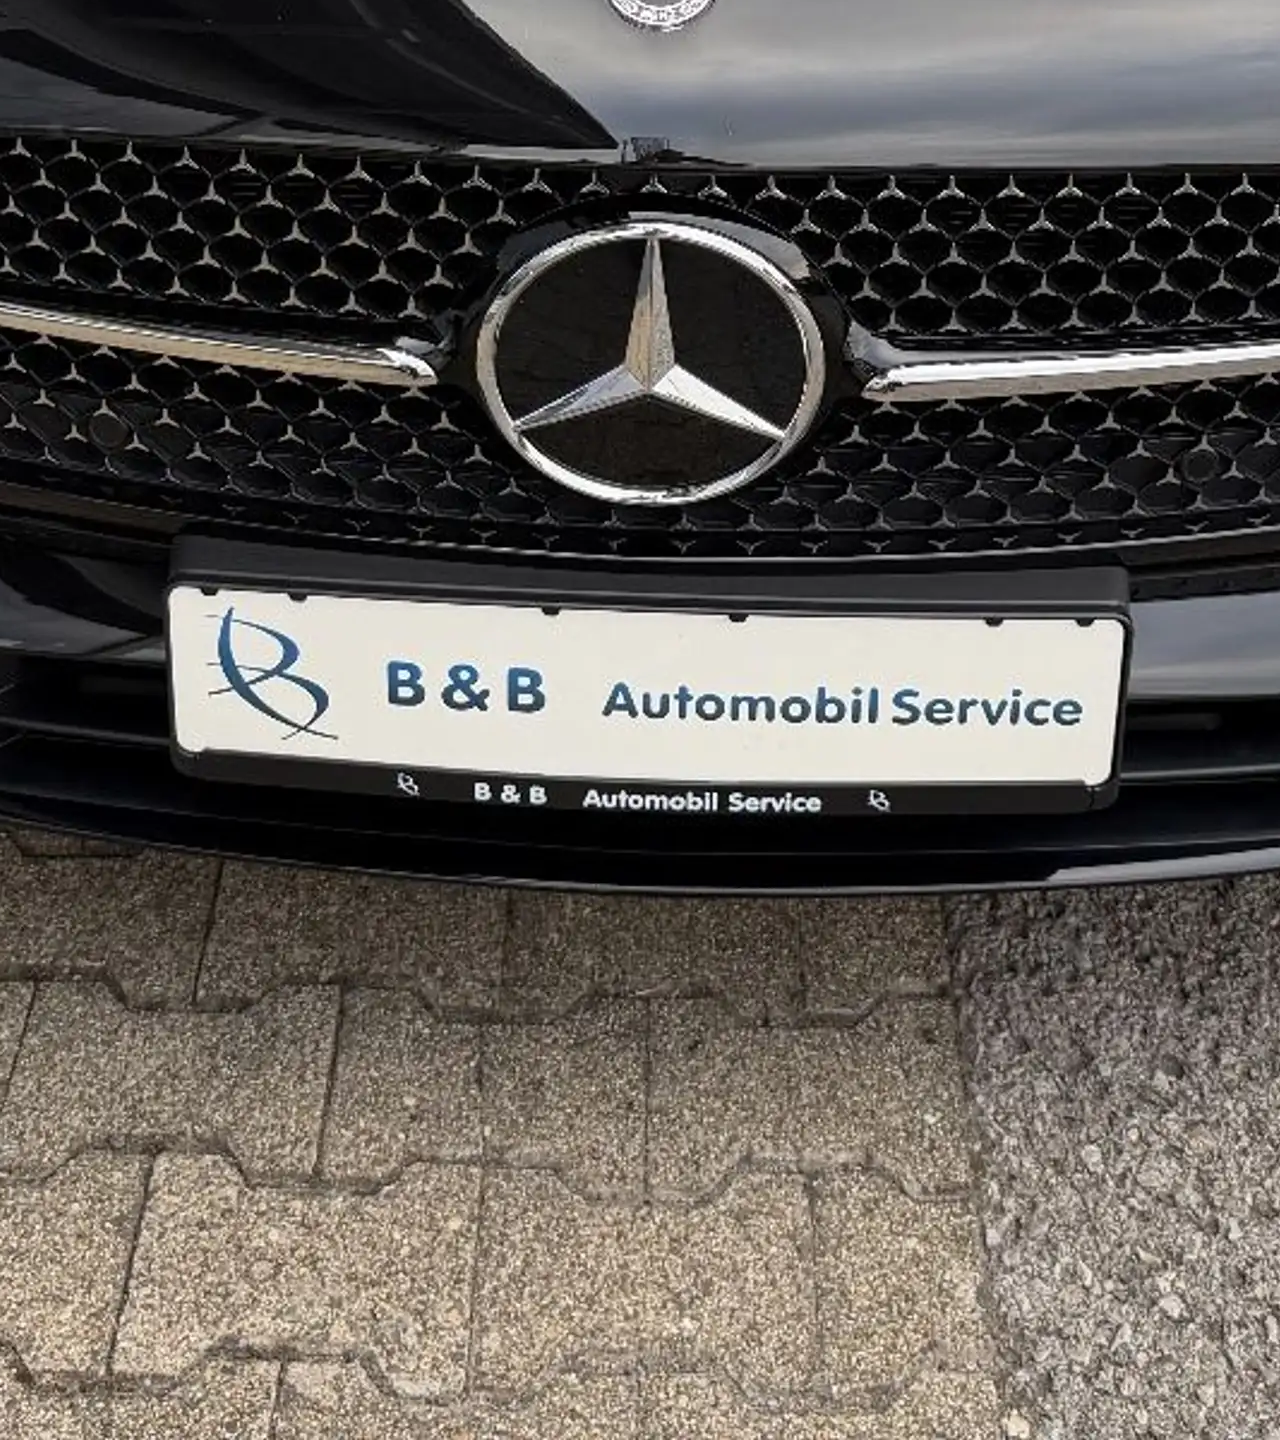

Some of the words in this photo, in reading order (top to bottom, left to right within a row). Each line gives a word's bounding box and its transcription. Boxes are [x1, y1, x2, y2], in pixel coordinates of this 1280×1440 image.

[387, 661, 425, 707] B
[441, 664, 490, 712] &
[507, 667, 546, 714] B
[601, 681, 880, 724] Automobil
[892, 688, 1083, 727] Service
[474, 782, 493, 802] B
[500, 784, 521, 804] &
[529, 785, 548, 805] B
[582, 787, 719, 812] Automobil
[727, 791, 822, 813] Service
